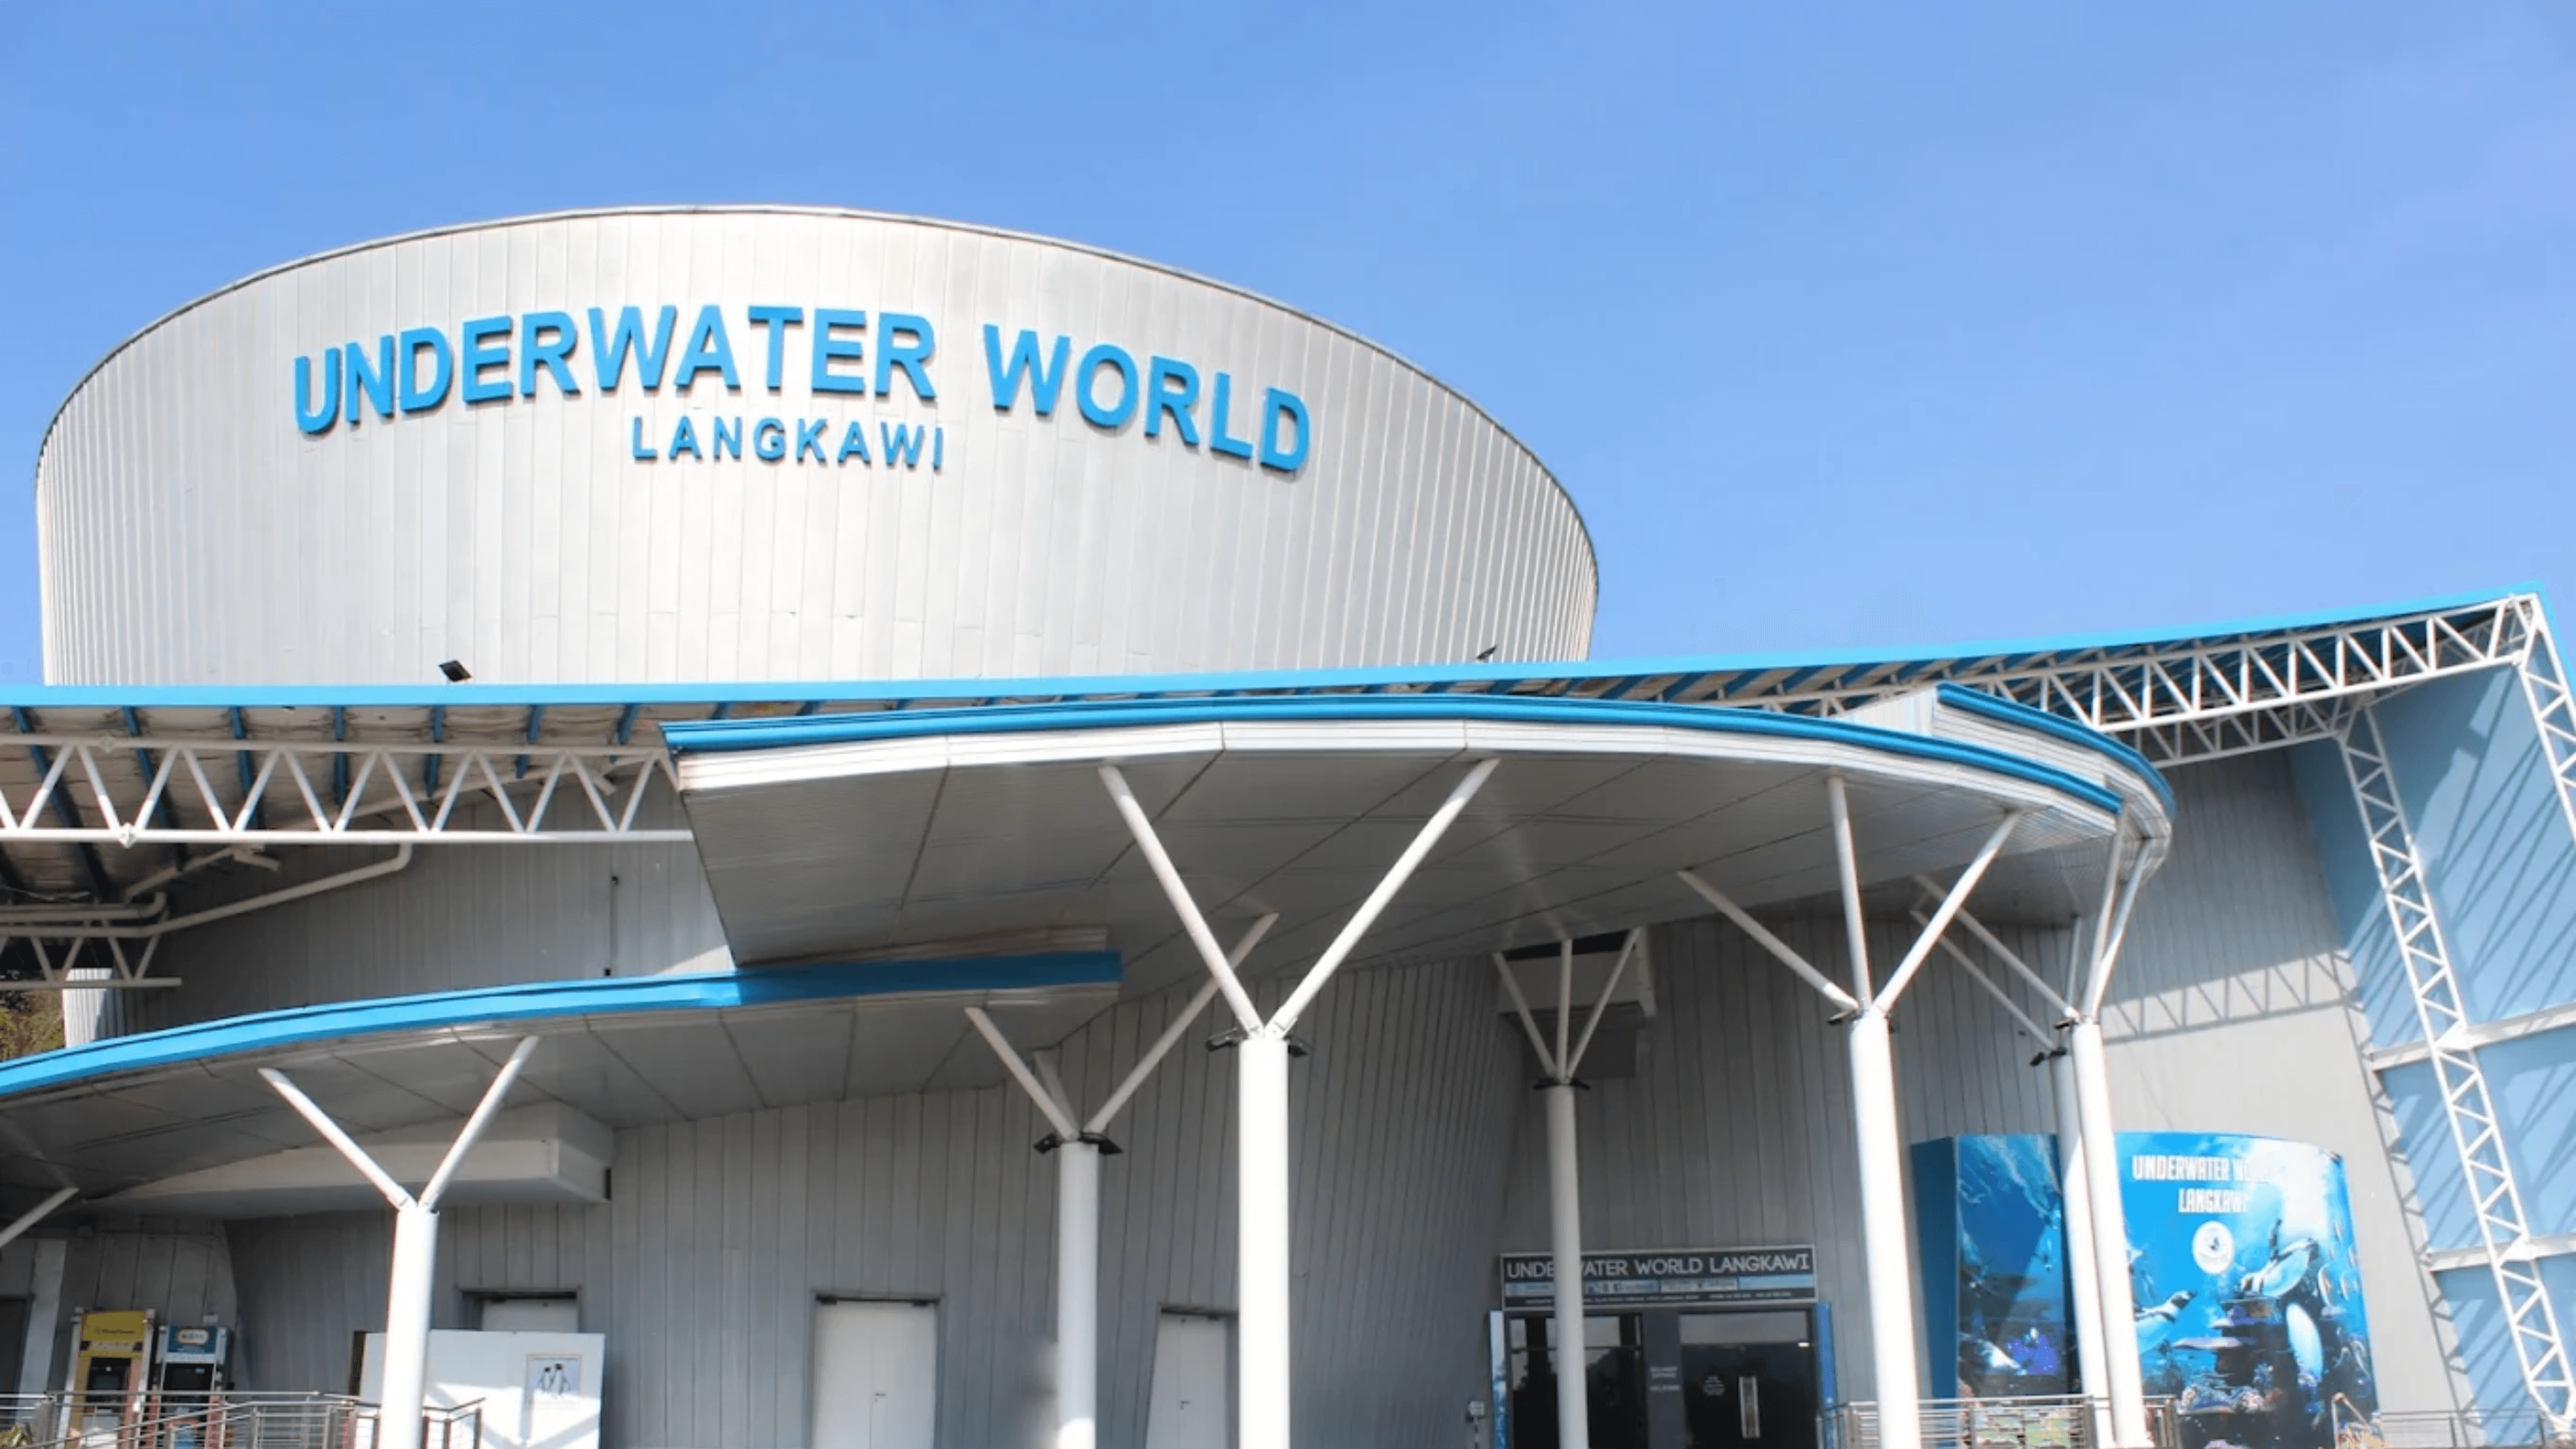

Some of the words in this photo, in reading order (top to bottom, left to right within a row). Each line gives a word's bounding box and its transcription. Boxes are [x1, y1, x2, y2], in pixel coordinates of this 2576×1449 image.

[294, 304, 936, 436] UNDERWATER
[983, 323, 1311, 474] WORLD
[633, 416, 945, 472] LANGKAWI
[2132, 1154, 2231, 1181] UNDERWATER
[1506, 1259, 1629, 1279] UNDEATER
[1634, 1257, 1703, 1275] WORLD
[1709, 1253, 1810, 1274] LANGKAWI
